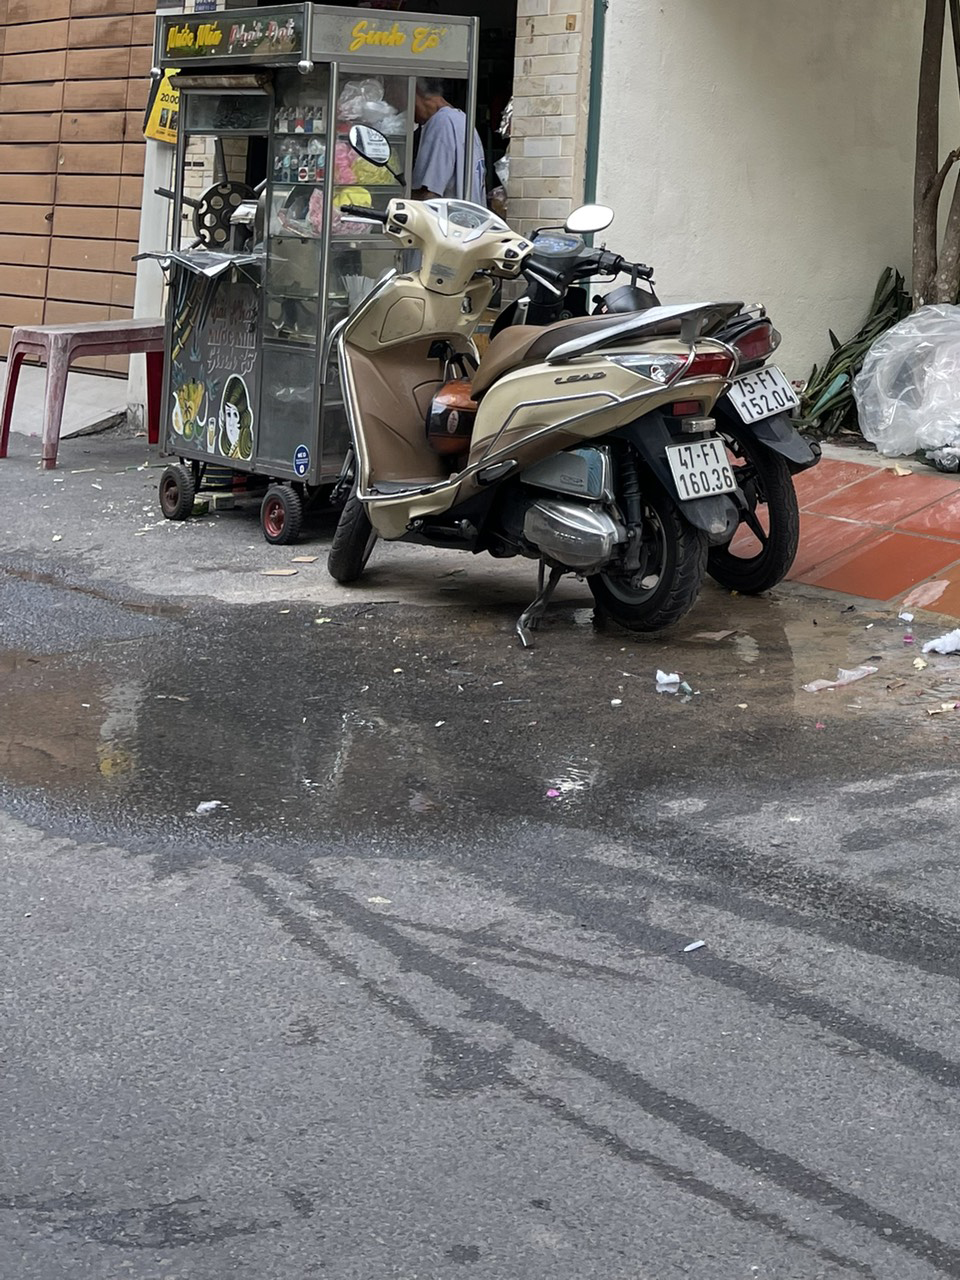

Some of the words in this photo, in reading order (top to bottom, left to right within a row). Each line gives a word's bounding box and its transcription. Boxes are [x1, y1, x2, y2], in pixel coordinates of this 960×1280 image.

[349, 20, 406, 51] Sinh
[554, 371, 606, 385] LEAD
[741, 388, 795, 419] 152.04
[679, 467, 733, 496] 160.36
